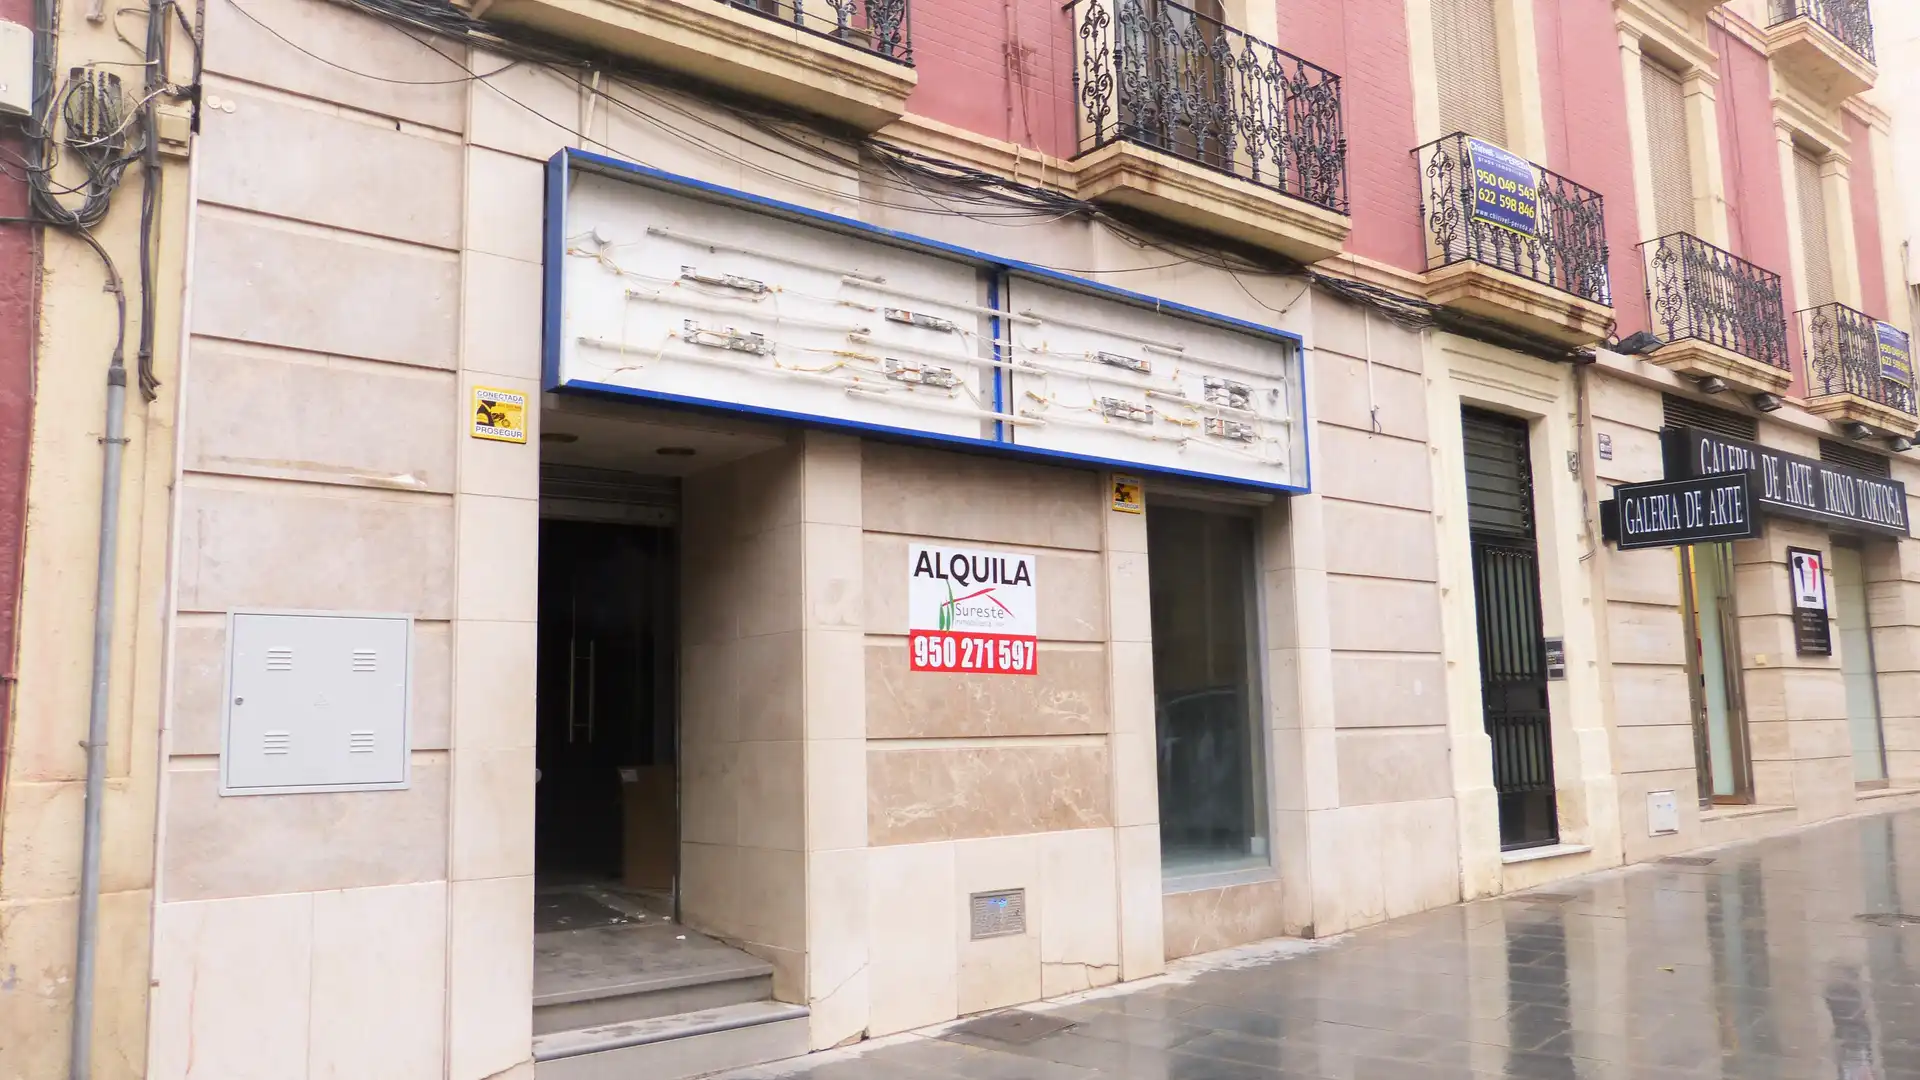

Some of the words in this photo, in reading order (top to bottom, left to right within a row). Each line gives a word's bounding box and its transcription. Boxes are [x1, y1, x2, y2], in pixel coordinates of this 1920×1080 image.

[1476, 169, 1496, 186] 950
[1498, 177, 1516, 193] 049
[1518, 184, 1535, 201] 543
[1478, 188, 1496, 204] 622
[1499, 194, 1517, 212] 598
[1518, 202, 1534, 219] 846
[477, 390, 523, 402] CONECTADA
[475, 426, 523, 438] PROSEGUR
[1761, 454, 1781, 500] DE
[1786, 459, 1815, 508] ARTE
[1820, 469, 1855, 516] TRINO
[1856, 478, 1904, 526] TORTOSA
[1625, 492, 1681, 535] GALERIA
[1684, 490, 1704, 528] DE
[1708, 485, 1743, 526] ARTE
[913, 550, 1031, 587] ALQUILA
[955, 602, 1004, 619] Sureste
[914, 635, 956, 668] 950
[961, 637, 994, 669] 271
[999, 640, 1034, 671] 597
